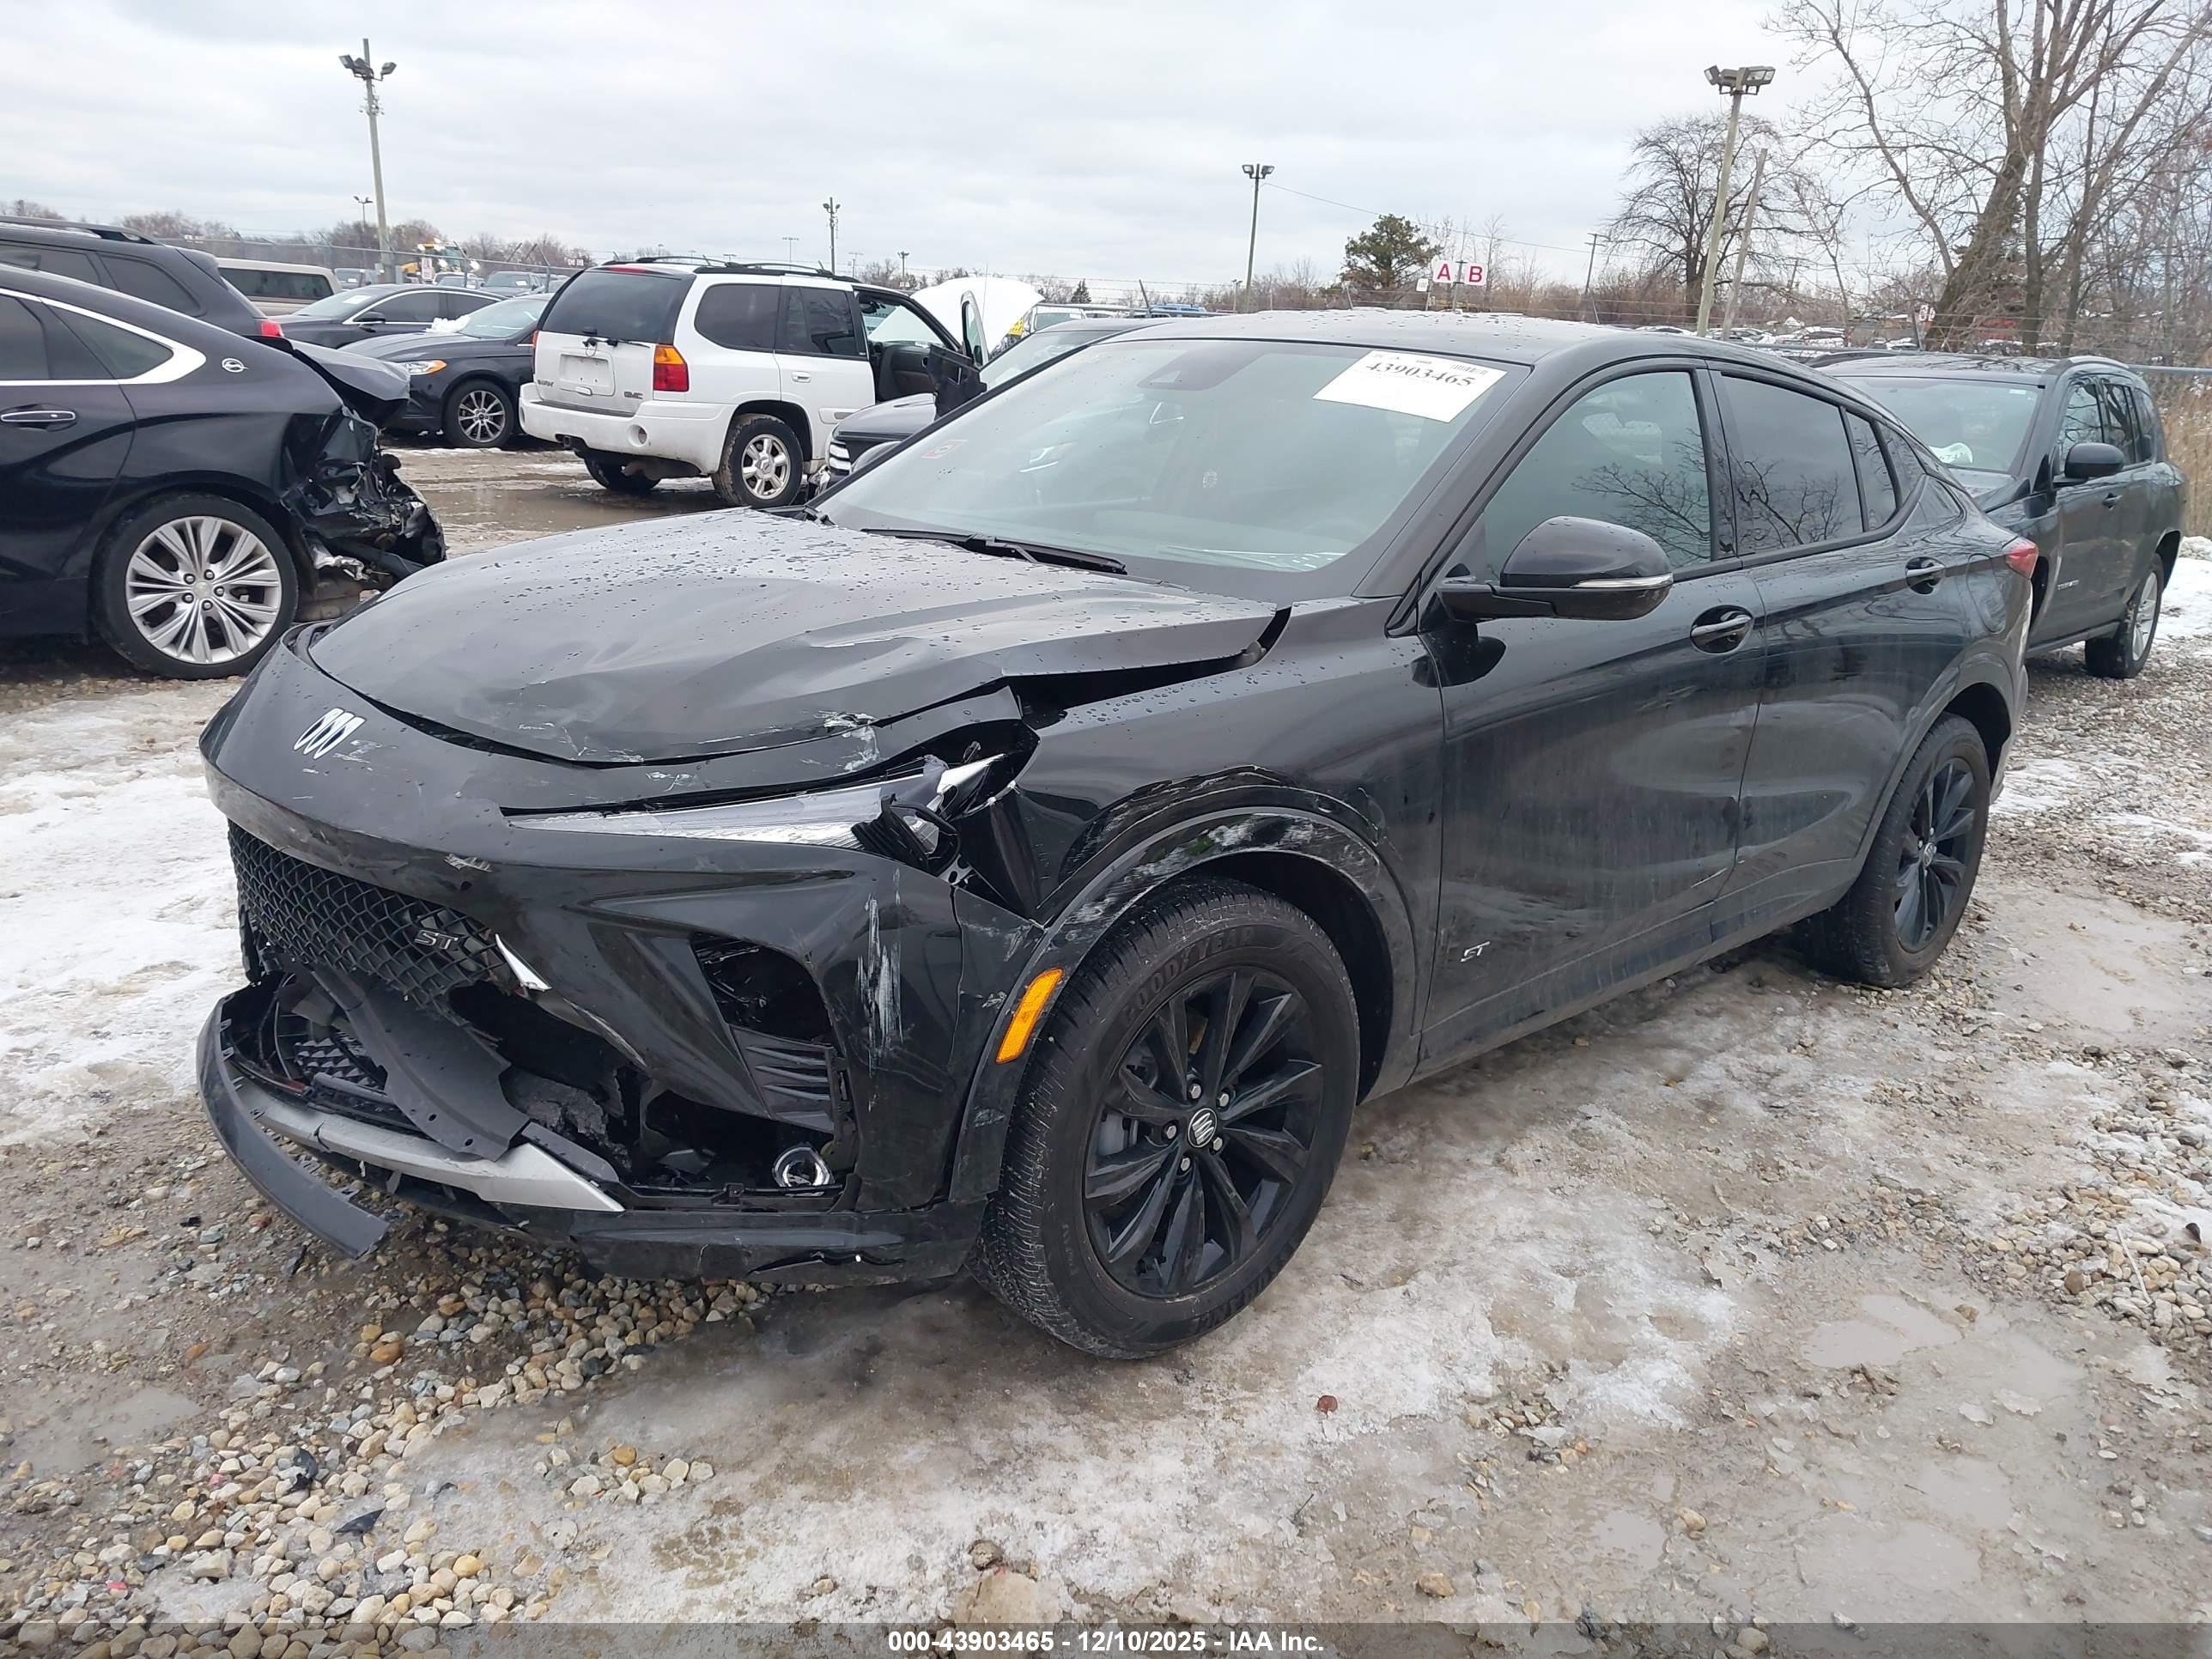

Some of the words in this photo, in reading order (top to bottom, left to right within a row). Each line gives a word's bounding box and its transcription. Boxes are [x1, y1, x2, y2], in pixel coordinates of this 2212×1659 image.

[1437, 263, 1451, 281] A
[1468, 265, 1483, 283] B
[1366, 362, 1475, 386] 43903465
[414, 928, 459, 950] ST
[1460, 940, 1491, 963] GT
